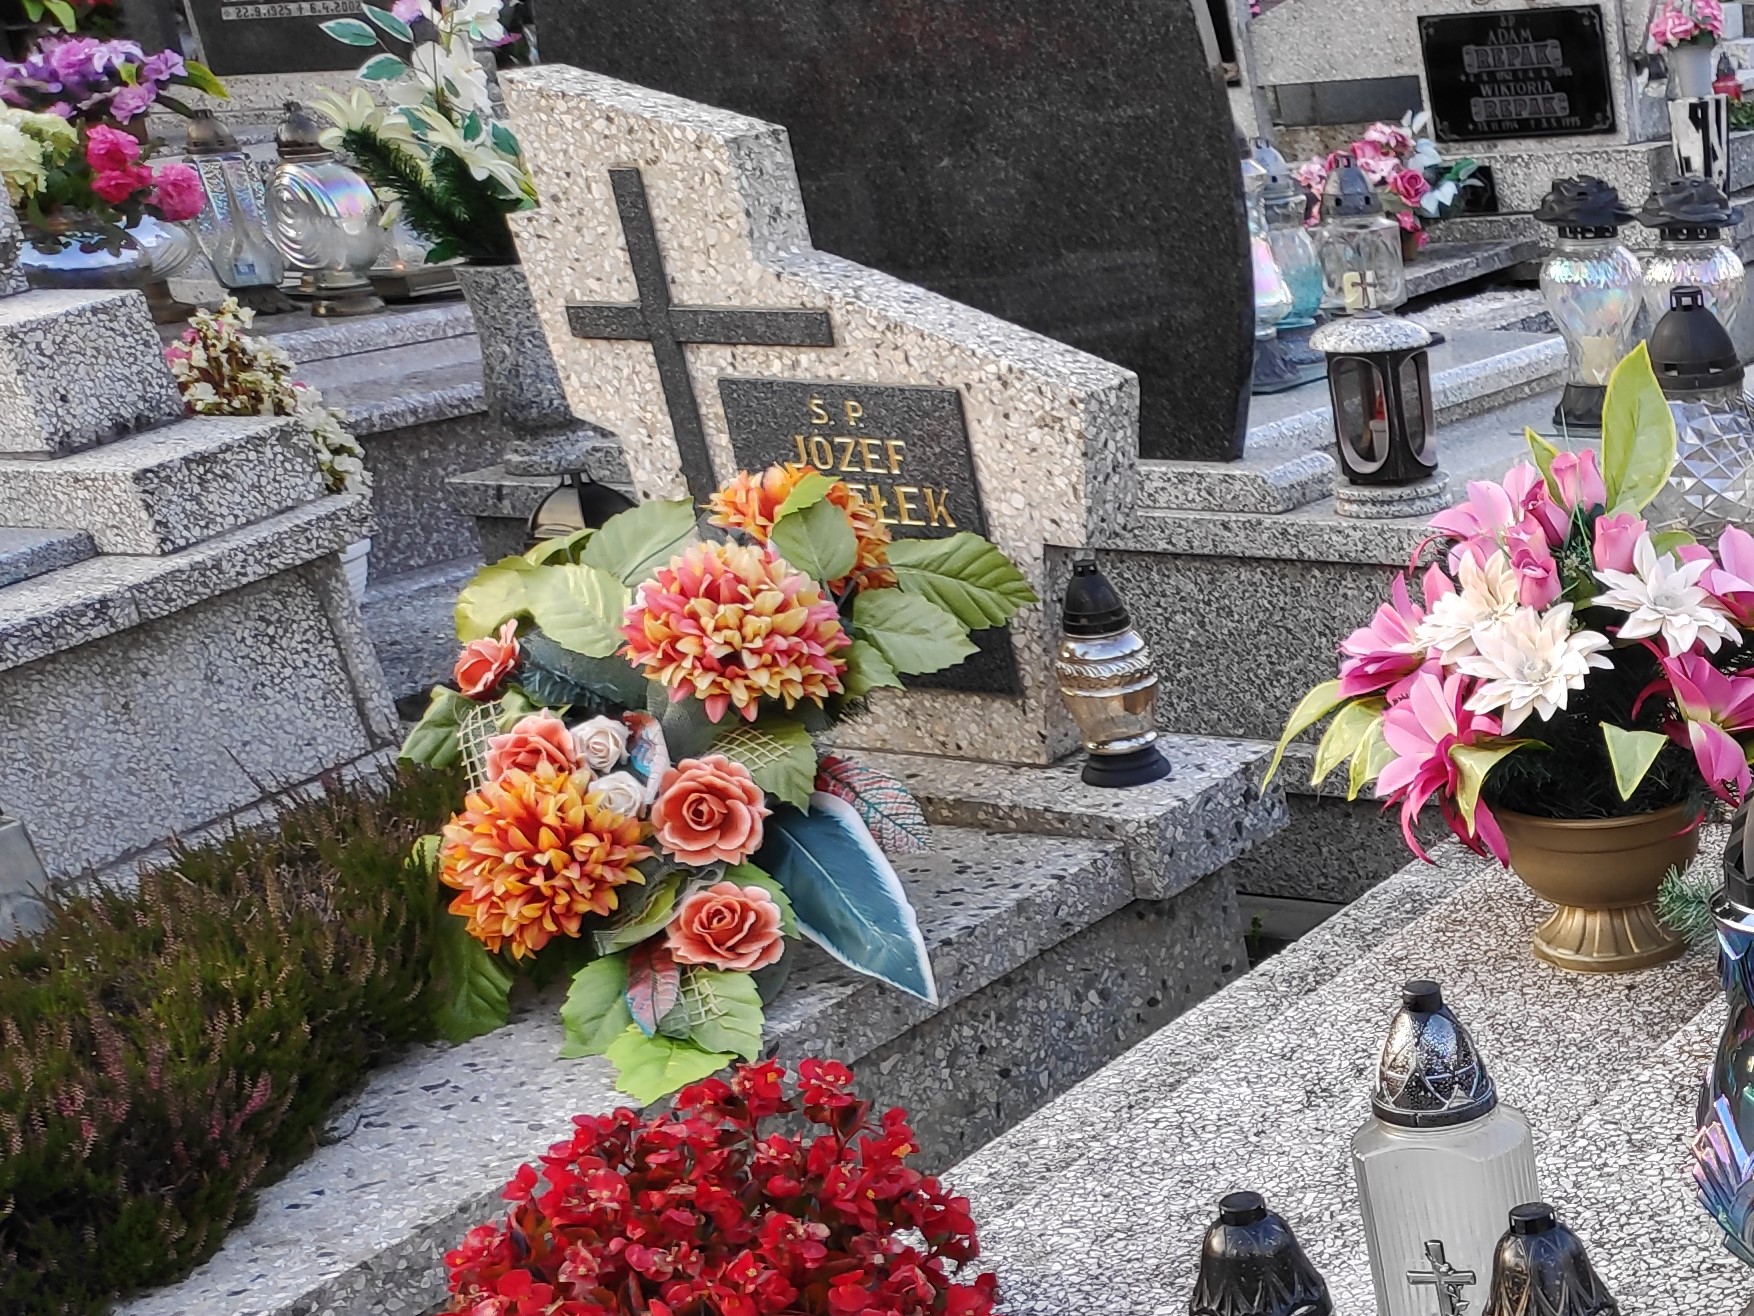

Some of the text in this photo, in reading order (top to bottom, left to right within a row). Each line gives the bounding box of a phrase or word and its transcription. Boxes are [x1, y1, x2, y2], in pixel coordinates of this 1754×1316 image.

[1487, 28, 1533, 45] ADAM
[1476, 44, 1552, 69] REPAK
[1479, 80, 1554, 97] WIKTORIA
[1484, 97, 1558, 119] REPAK
[845, 483, 958, 529] ŁEK
